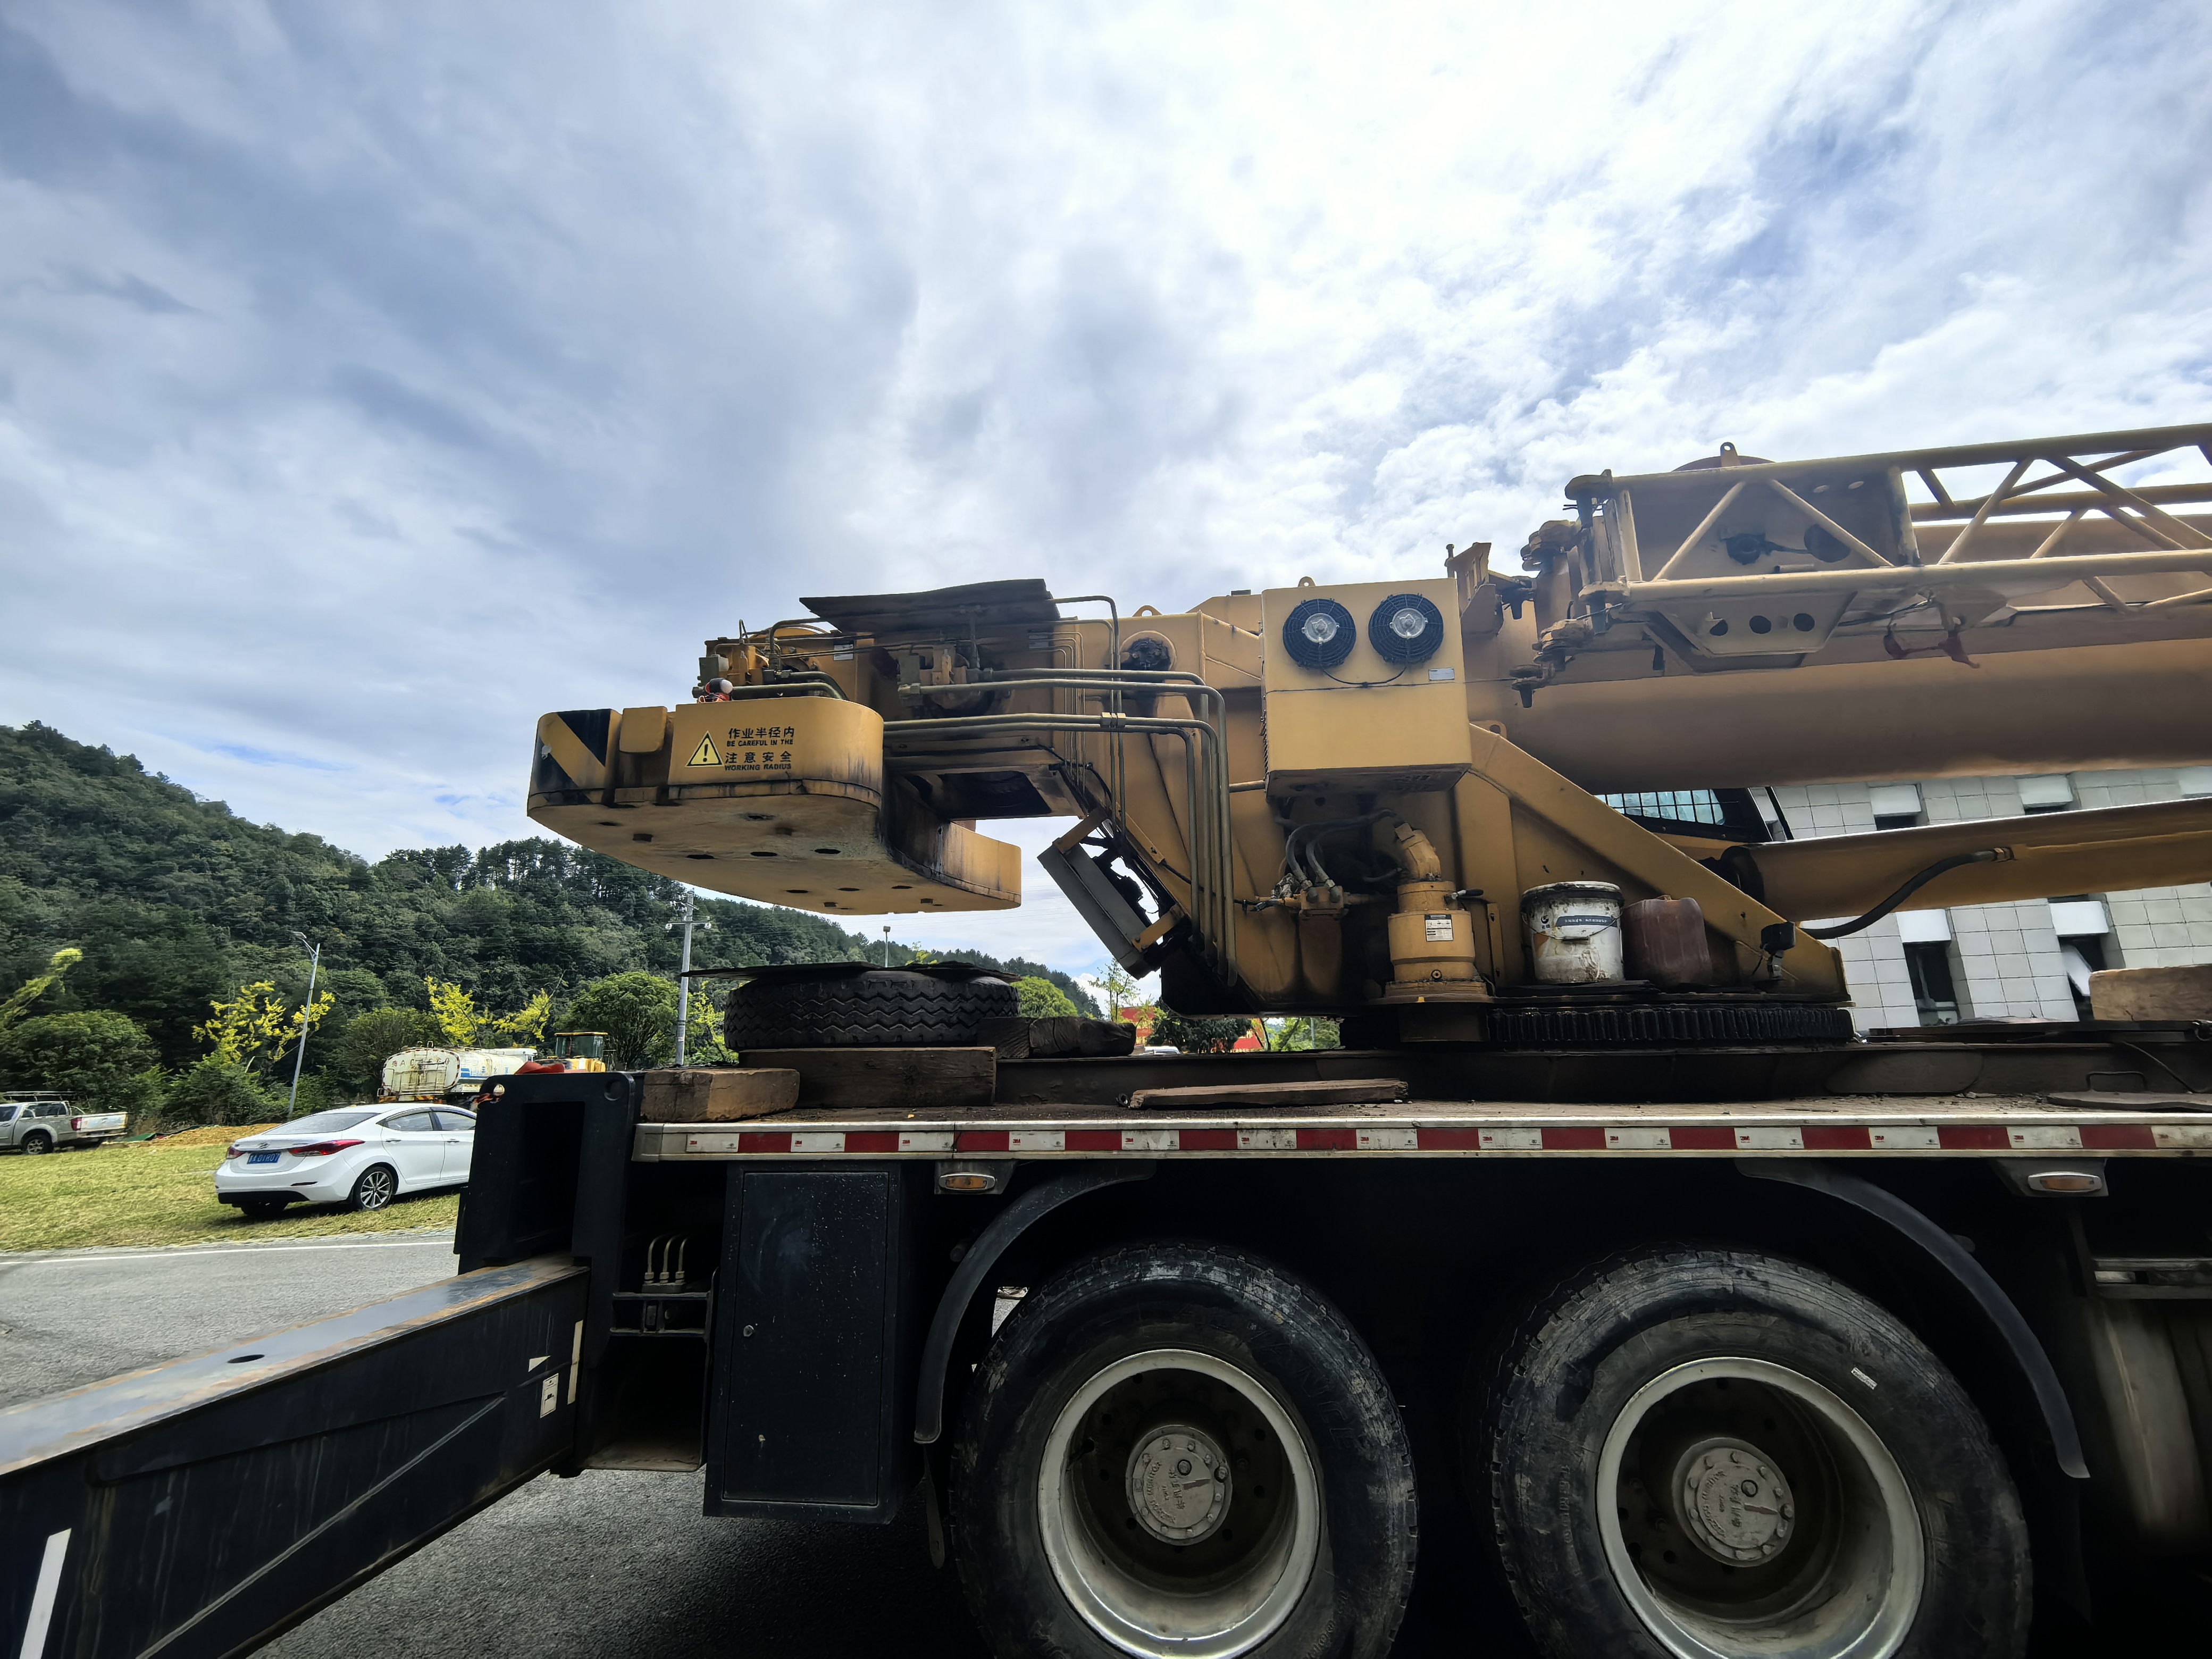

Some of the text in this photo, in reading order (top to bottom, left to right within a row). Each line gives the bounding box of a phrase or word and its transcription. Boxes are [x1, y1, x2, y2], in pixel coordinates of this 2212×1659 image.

[728, 726, 794, 739] 作业半径内
[725, 750, 792, 764] 注意安全
